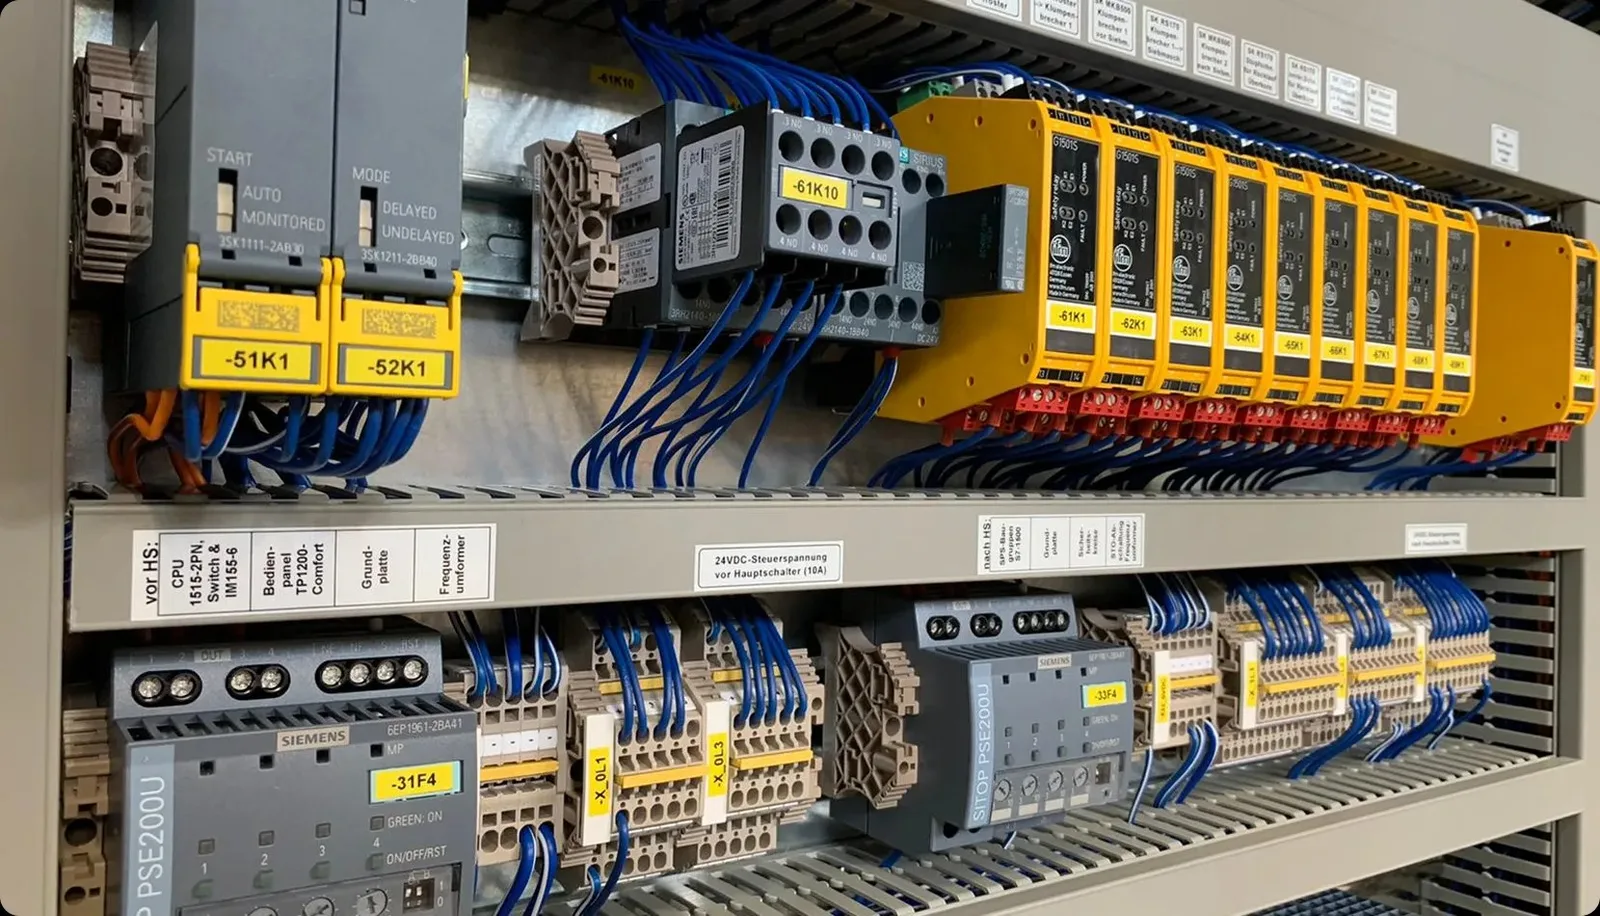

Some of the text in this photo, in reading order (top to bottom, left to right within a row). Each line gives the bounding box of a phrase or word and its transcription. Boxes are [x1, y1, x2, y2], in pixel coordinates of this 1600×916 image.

[598, 73, 634, 90] -61K10
[1053, 136, 1079, 151] G1501S
[207, 147, 253, 166] START
[913, 153, 944, 169] SIRIUS
[1116, 150, 1139, 164] G1501S
[352, 167, 391, 184] MODE
[242, 186, 281, 202] AUTO
[793, 180, 838, 200] -61K10
[383, 201, 437, 220] DELAYED
[242, 210, 325, 231] MONITORED
[382, 225, 454, 244] UNDELAYED
[220, 235, 304, 255] 3SK1111-2AB30
[362, 249, 437, 267] 3SK1211-2BB40
[1059, 311, 1085, 322] -61K1
[1121, 318, 1146, 331] -62K1
[1180, 326, 1203, 337] -63K1
[226, 352, 289, 370] -51K1
[368, 360, 425, 377] -52K1
[983, 519, 991, 570] nach HS:
[362, 546, 372, 589] Grund-
[378, 550, 389, 584] platte
[439, 534, 452, 595] Frequenz-
[455, 535, 465, 594] umformer
[715, 554, 827, 565] 24VDC-Steuerspannung
[143, 542, 159, 605] vor HS:
[172, 560, 184, 588] CPU
[190, 540, 205, 606] 1515-2PN,
[208, 544, 220, 602] Switch &
[225, 548, 238, 598] IM155-6
[263, 546, 275, 596] Bedien-
[280, 553, 293, 588] panel
[296, 544, 308, 595] TP1200-
[312, 543, 324, 595] Comfort
[734, 568, 801, 579] Hauptschalter
[804, 566, 827, 576] (10A)
[201, 650, 223, 661] OUT
[1040, 655, 1070, 666] SIEMENS
[1094, 691, 1117, 700] -33F4
[388, 719, 462, 736] 6EP1961-2BA41
[282, 730, 346, 747] SIEMENS
[1033, 738, 1037, 746] 2
[387, 744, 404, 755] MP
[973, 684, 992, 821] SITOP PSE200U
[714, 741, 726, 787] -X_0L3
[392, 773, 436, 790] -31F4
[595, 757, 609, 804] -X_0L1
[388, 811, 443, 828] GREEN: ON
[137, 776, 165, 898] PSE200U
[373, 838, 380, 848] 4
[261, 854, 268, 865] 2
[320, 846, 326, 857] 3
[386, 846, 447, 865] ON/OFF/RST
[202, 863, 207, 874] 1
[440, 882, 443, 890] 1
[438, 898, 443, 907] 0
